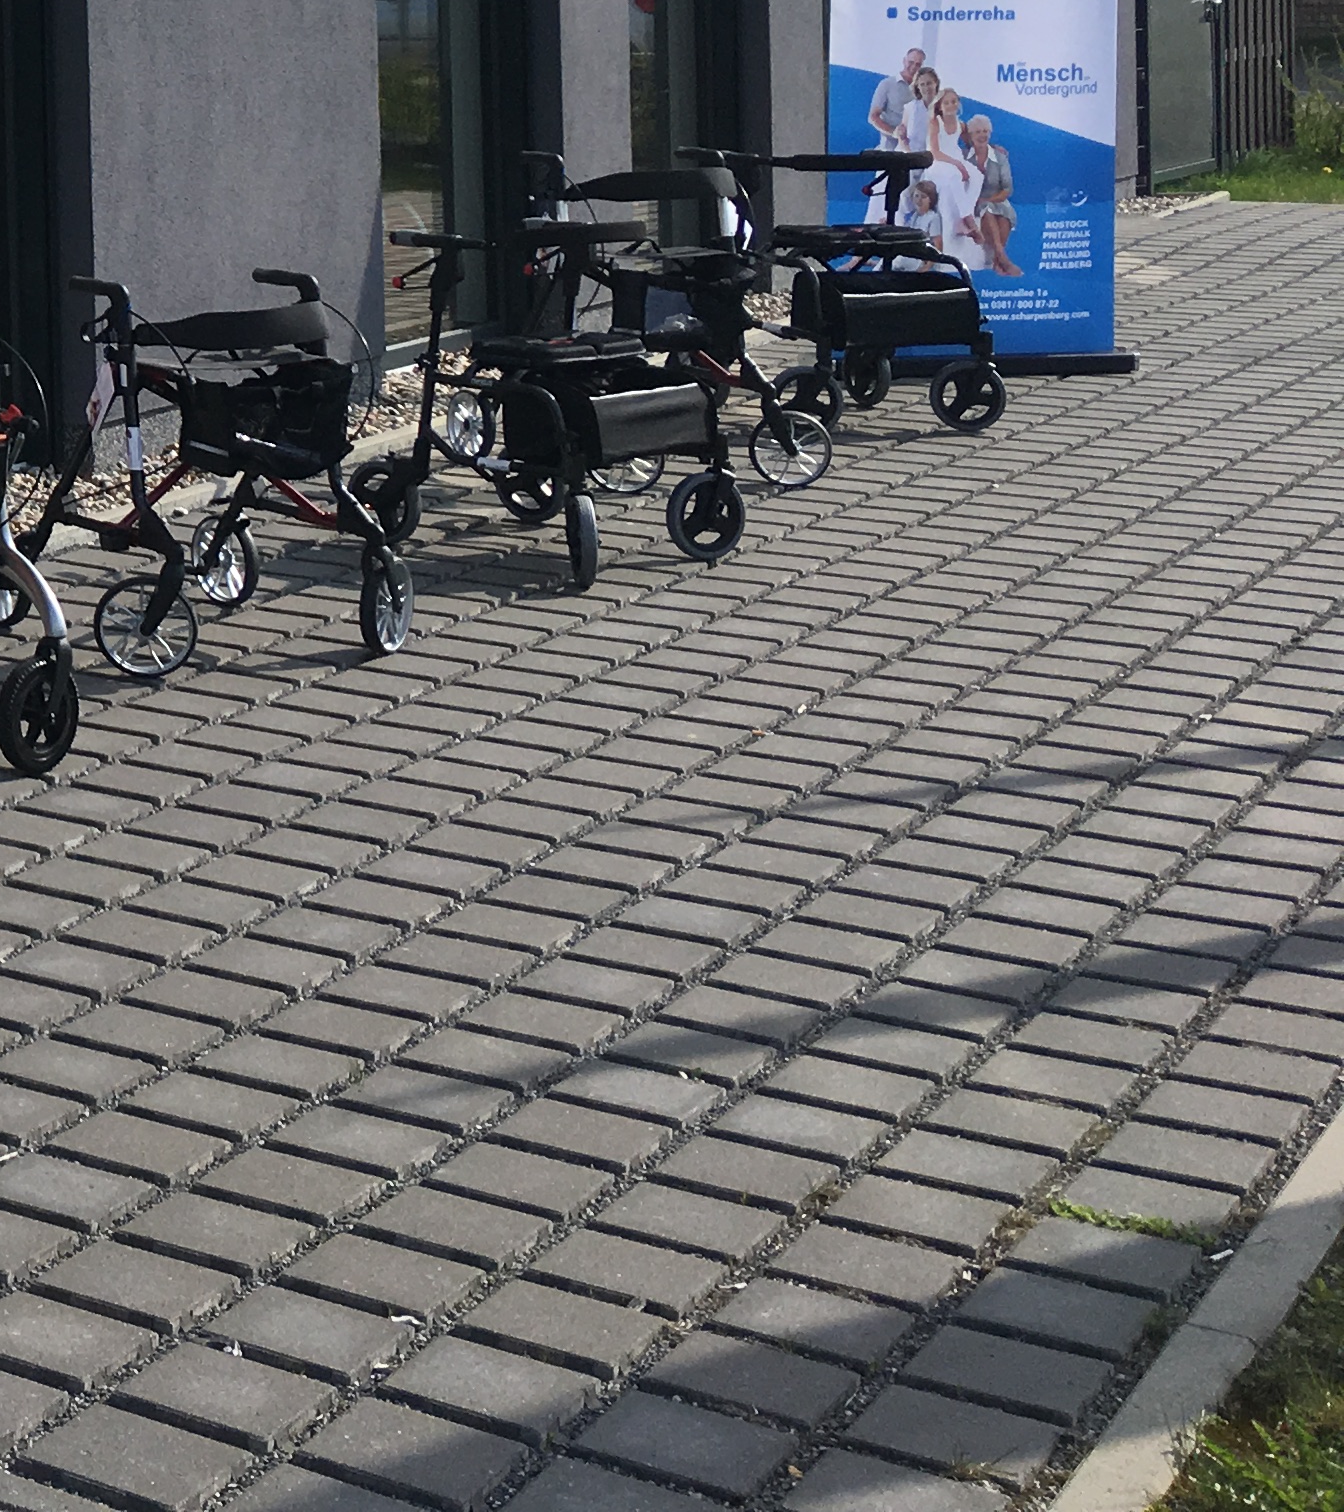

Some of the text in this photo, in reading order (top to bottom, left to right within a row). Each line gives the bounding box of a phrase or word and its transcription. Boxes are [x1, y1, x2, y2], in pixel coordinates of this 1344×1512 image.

[907, 5, 1016, 21] Sonderreha
[996, 62, 1083, 83] Mensch
[1015, 80, 1098, 98] Vordergrund
